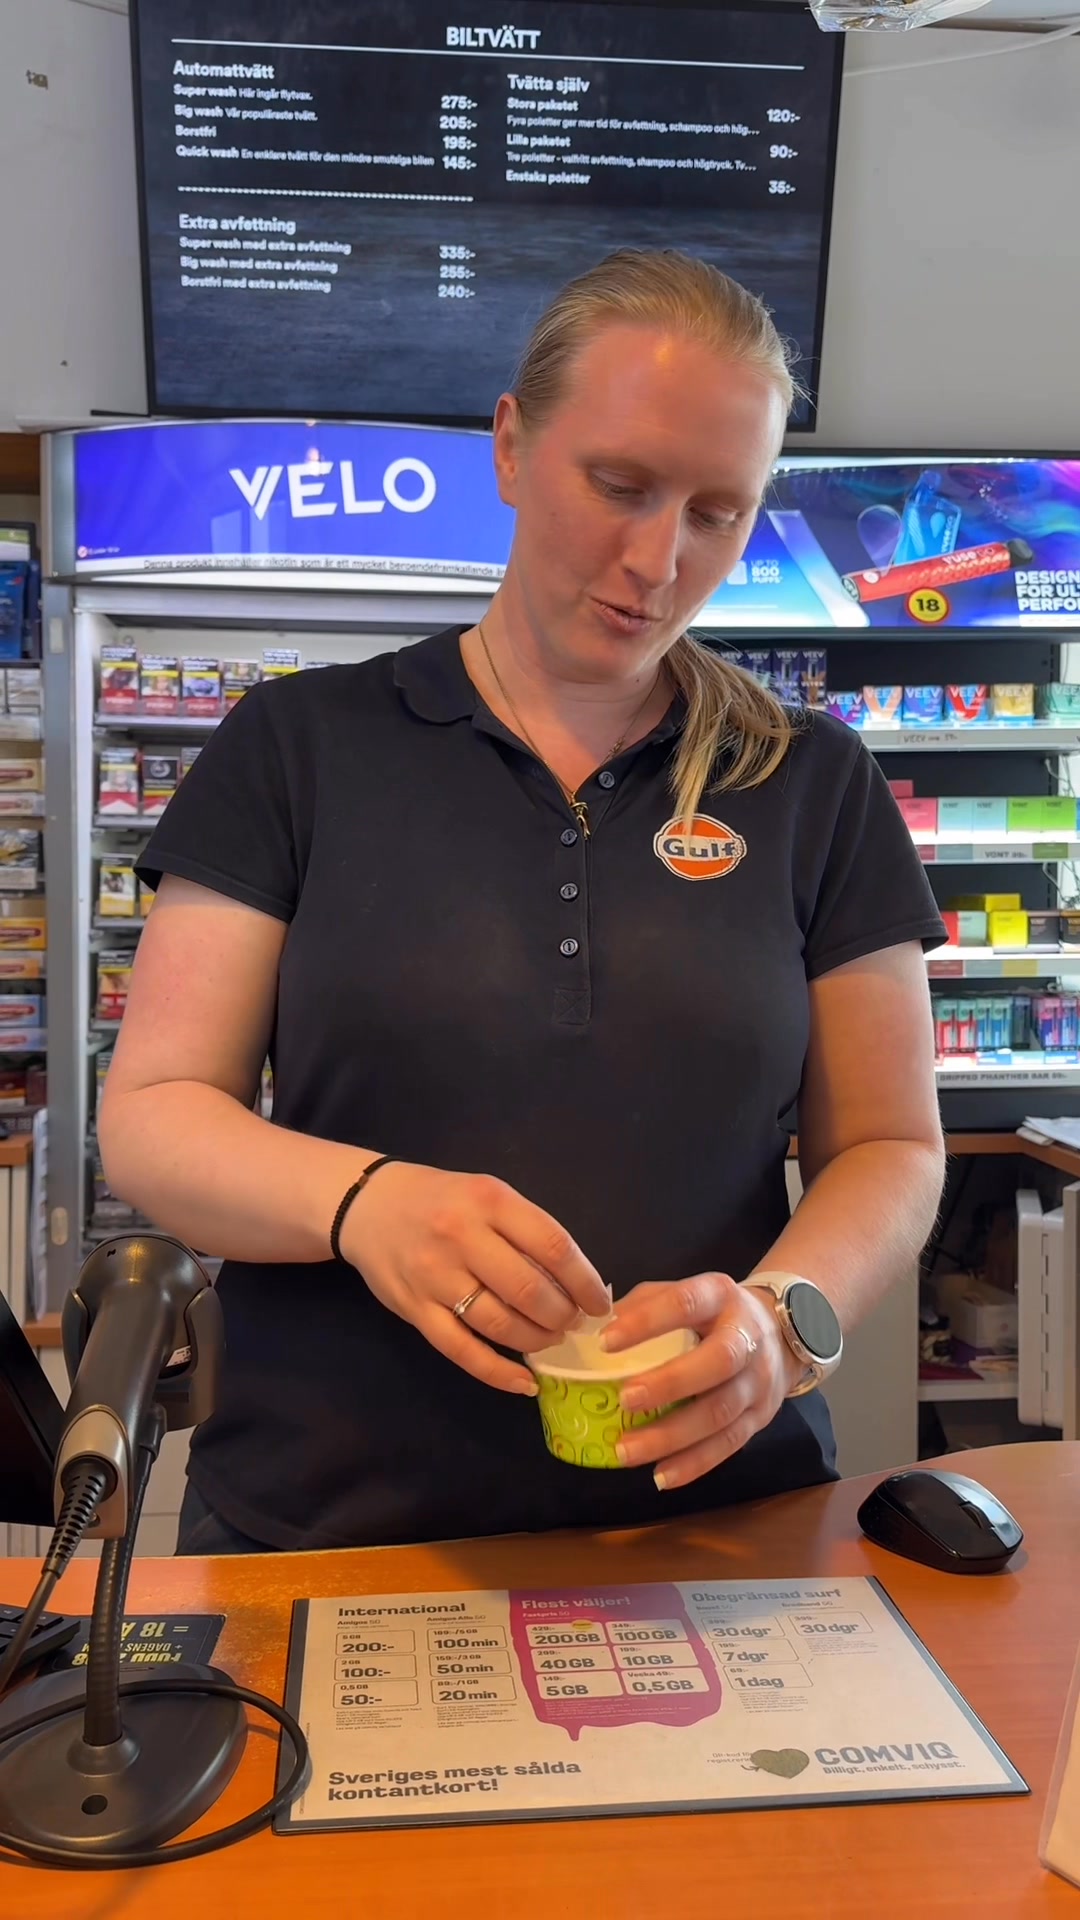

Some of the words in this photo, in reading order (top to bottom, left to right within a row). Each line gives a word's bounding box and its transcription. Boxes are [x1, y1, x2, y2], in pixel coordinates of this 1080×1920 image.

[446, 26, 541, 49] BILTVÄTT
[173, 60, 275, 79] Automattvätt
[173, 84, 206, 98] Super
[208, 86, 237, 98] wash
[239, 88, 256, 98] Här
[507, 74, 554, 90] Tvätta
[556, 76, 590, 94] själv
[441, 95, 478, 110] 275:-
[507, 97, 536, 109] Stora
[537, 99, 578, 112] paketet
[174, 104, 193, 118] Big
[194, 106, 224, 118] wash
[766, 108, 800, 123] 120:-
[440, 116, 478, 130] 205:-
[507, 115, 526, 127] Fyra
[528, 116, 562, 128] poletter
[609, 119, 622, 129] för
[714, 124, 730, 134] och
[175, 124, 217, 137] Borstfri
[442, 136, 477, 150] 195:-
[506, 134, 529, 146] Lilla
[530, 135, 571, 148] paketet
[176, 145, 210, 157] Quick
[210, 146, 240, 158] wash
[770, 145, 798, 158] 90:-
[442, 156, 477, 170] 145:-
[506, 170, 547, 182] Enstaka
[548, 172, 591, 186] poletter
[768, 180, 796, 194] 35:-
[179, 214, 218, 230] Extra
[220, 216, 296, 235] avfettning
[179, 236, 211, 250] Super
[212, 238, 241, 250] wash
[242, 240, 266, 250] med
[268, 240, 295, 251] extra
[297, 240, 352, 255] avfettning
[439, 246, 476, 260] 335:-
[180, 256, 198, 270] Big
[200, 257, 228, 268] wash
[229, 258, 253, 270] med
[255, 258, 282, 270] extra
[284, 260, 338, 274] avfettning
[440, 265, 476, 280] 255:-
[181, 275, 222, 288] Borstfri
[223, 277, 246, 288] med
[248, 278, 276, 290] extra
[277, 278, 331, 293] avfettning
[438, 285, 476, 298] 240:-
[229, 457, 436, 520] VELO
[752, 566, 780, 577] 800
[1016, 585, 1054, 598] FOR
[916, 598, 940, 612] 18
[827, 693, 862, 704] VEEV
[906, 687, 942, 698] VEEV
[950, 686, 985, 698] VEEV
[663, 838, 734, 858] Gulf
[522, 1600, 570, 1608] Flest
[572, 1596, 631, 1608] väljer!
[692, 1590, 801, 1602] Obegränsad
[804, 1588, 842, 1598] surf
[338, 1603, 466, 1616] International
[140, 1622, 166, 1637] 18
[615, 1632, 650, 1642] 100
[652, 1630, 677, 1640] GB
[434, 1638, 469, 1648] 100
[471, 1639, 498, 1647] min
[535, 1634, 572, 1644] 200
[575, 1634, 600, 1642] GB
[125, 1643, 172, 1652] DAGENS
[342, 1642, 394, 1652] 200:-
[540, 1660, 567, 1670] 40
[569, 1658, 595, 1668] GB
[623, 1656, 646, 1666] 10
[648, 1655, 674, 1664] GB
[722, 1652, 734, 1662] 7
[737, 1652, 768, 1662] dgr
[341, 1668, 391, 1678] 100:-
[437, 1664, 464, 1674] 50
[466, 1664, 494, 1672] min
[546, 1686, 560, 1696] 5
[562, 1685, 588, 1696] GB
[632, 1681, 665, 1693] 0,5
[666, 1680, 694, 1690] GB
[341, 1694, 382, 1706] 50:-
[439, 1690, 466, 1700] 20
[468, 1691, 498, 1700] min
[814, 1742, 958, 1766] COMVIQ
[329, 1768, 438, 1786] Sveriges
[444, 1764, 507, 1780] mest
[514, 1760, 582, 1776] sålda
[328, 1778, 498, 1802] kontantkort!
